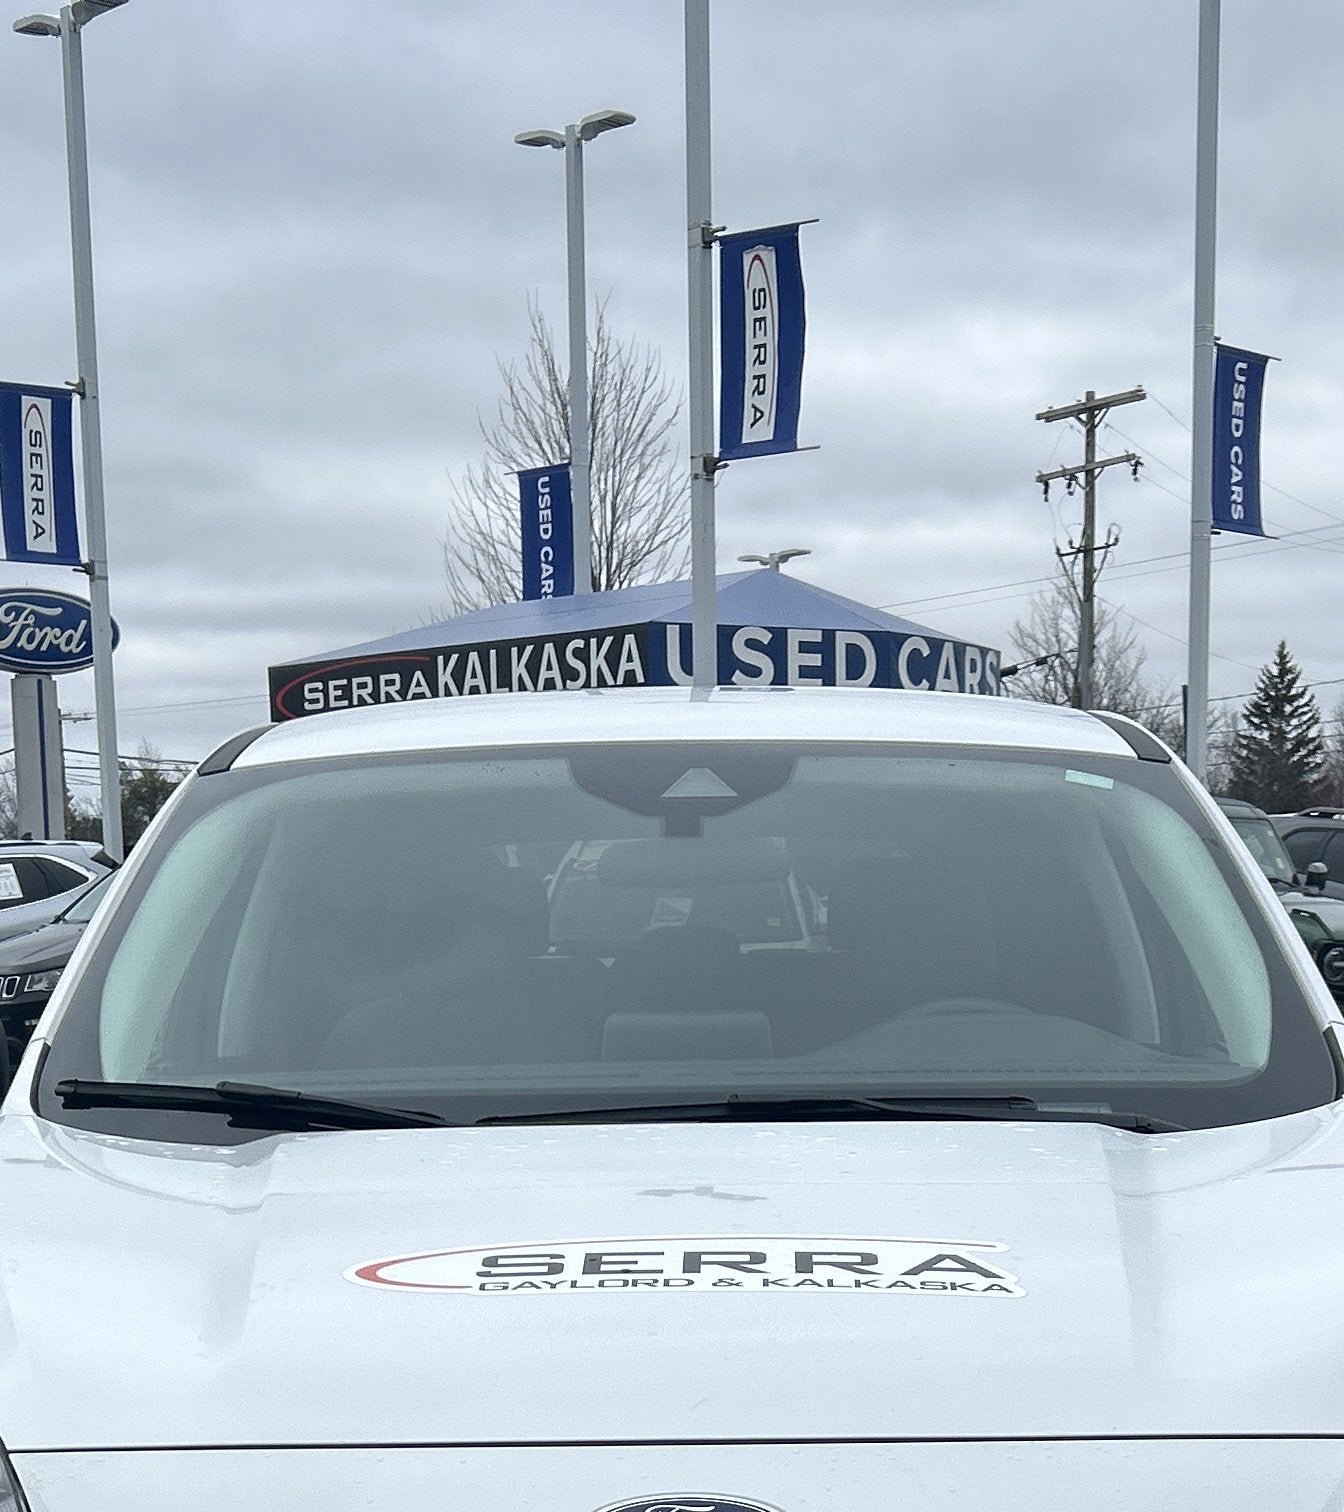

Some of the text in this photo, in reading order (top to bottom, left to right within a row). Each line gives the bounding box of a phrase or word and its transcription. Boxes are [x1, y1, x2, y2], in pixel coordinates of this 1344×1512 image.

[750, 287, 767, 428] SERRA
[1230, 361, 1248, 521] USED CARS
[29, 429, 47, 541] SERRA
[537, 476, 553, 540] USED
[303, 670, 432, 711] SERRA
[437, 633, 646, 697] KALKASKA
[898, 636, 1001, 697] CARS
[476, 1251, 1006, 1279] SERRA
[478, 1278, 1014, 1293] GAYLORD & KALKASKA
